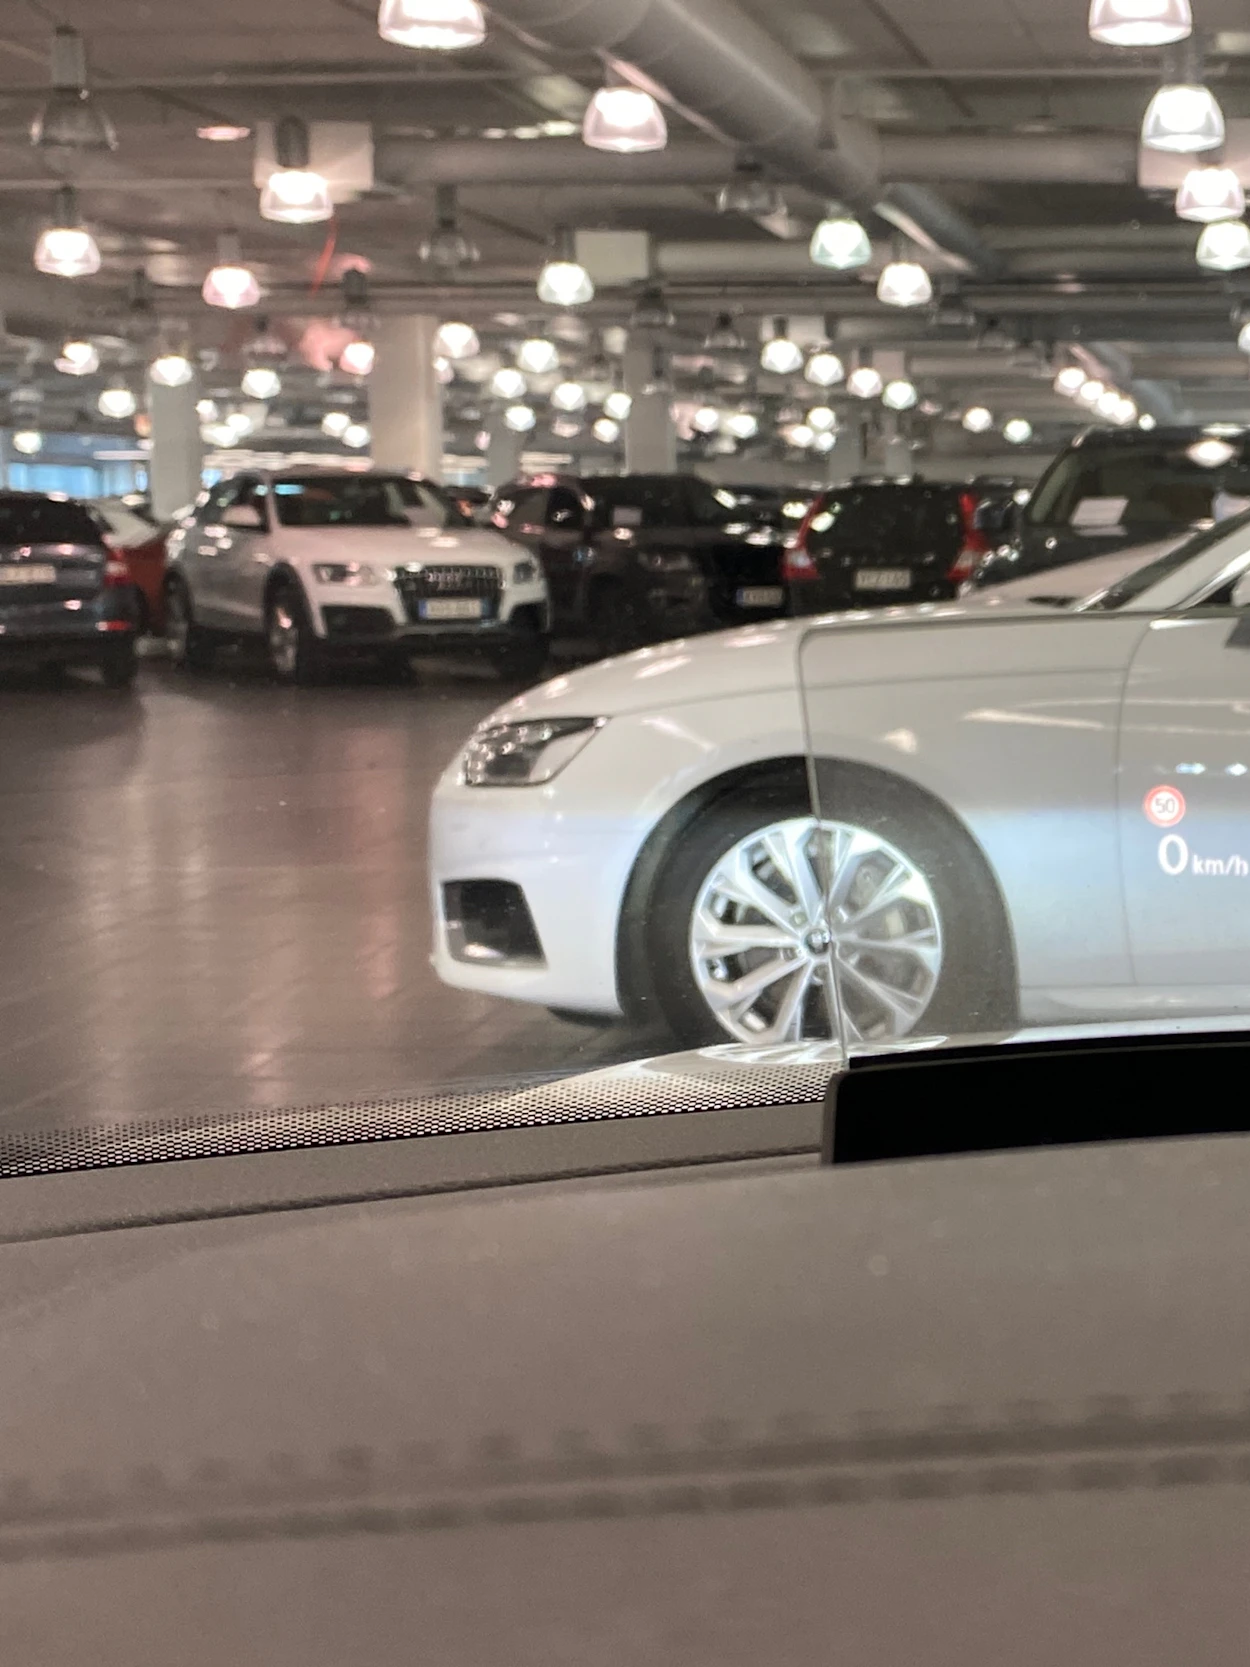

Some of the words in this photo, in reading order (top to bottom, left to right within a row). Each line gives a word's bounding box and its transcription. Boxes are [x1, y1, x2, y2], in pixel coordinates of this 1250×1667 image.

[1154, 797, 1176, 814] 50
[1157, 833, 1189, 875] 0
[1192, 853, 1249, 877] km/h
